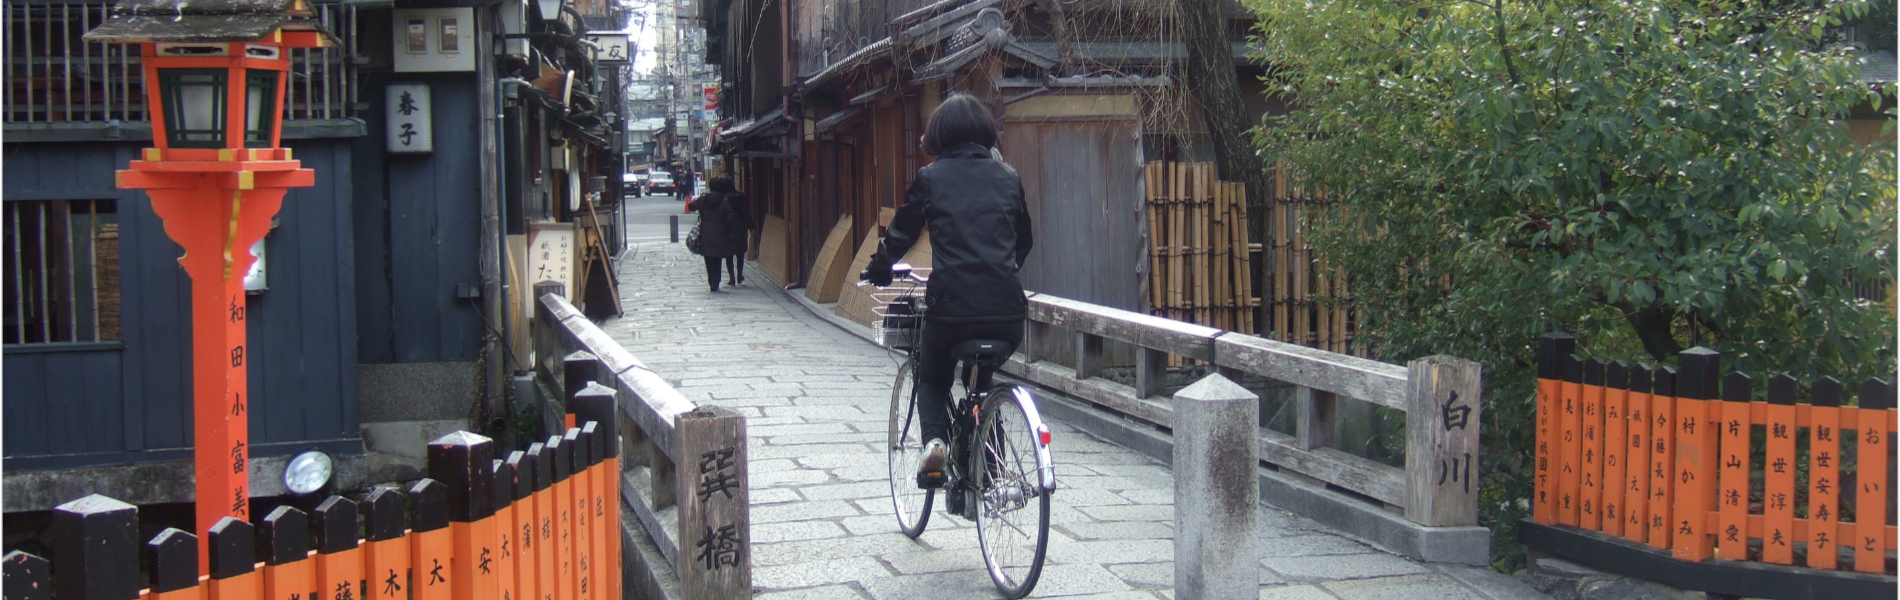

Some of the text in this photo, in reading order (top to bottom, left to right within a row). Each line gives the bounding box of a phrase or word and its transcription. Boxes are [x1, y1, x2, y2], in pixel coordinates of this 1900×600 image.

[397, 91, 419, 146] 春子
[229, 294, 246, 517] 和田小富美
[1438, 390, 1472, 494] 白川
[1562, 399, 1573, 509] 美の八重
[1606, 405, 1618, 519] みの家
[697, 447, 742, 570] 巽橋
[1679, 417, 1695, 535] 村かみ
[1725, 419, 1741, 542] 片山清愛
[1771, 422, 1788, 546] 観世淳夫
[1814, 424, 1832, 549] 観世安寿子
[1864, 427, 1880, 551] おいと
[383, 569, 401, 598] 木
[429, 558, 445, 586] 大
[479, 547, 492, 575] 安
